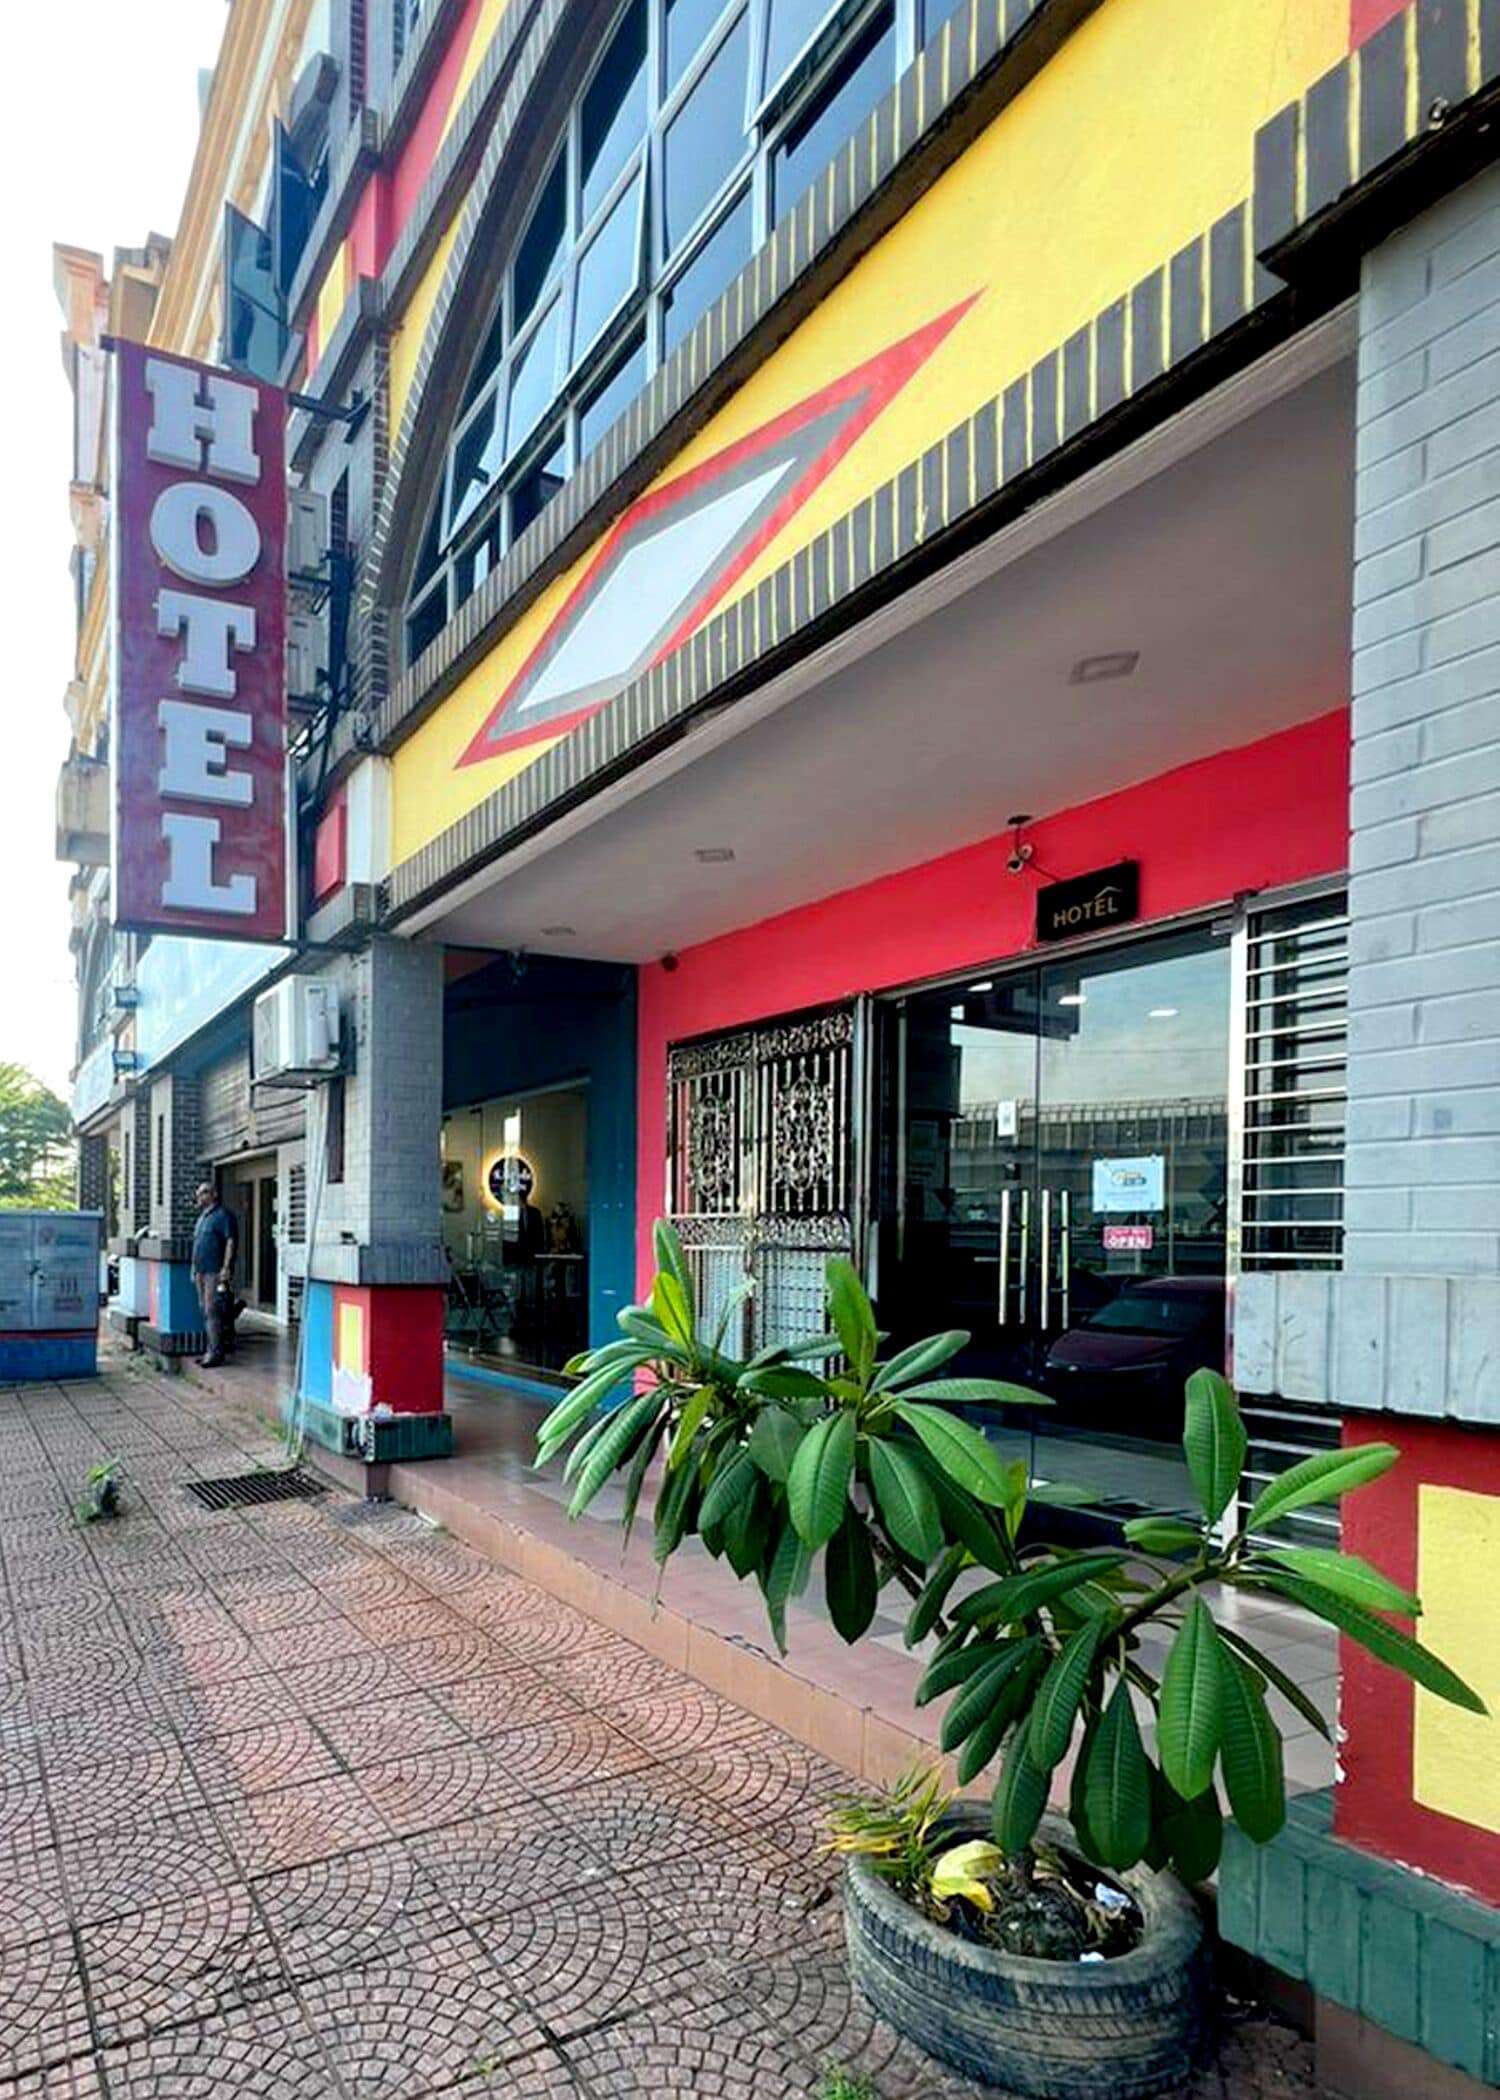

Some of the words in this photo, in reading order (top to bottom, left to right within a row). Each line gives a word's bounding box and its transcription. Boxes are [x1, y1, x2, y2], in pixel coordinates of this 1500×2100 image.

[145, 357, 261, 915] HOTEL
[1053, 896, 1119, 928] HOTEL
[1108, 1236, 1147, 1248] OPEN
